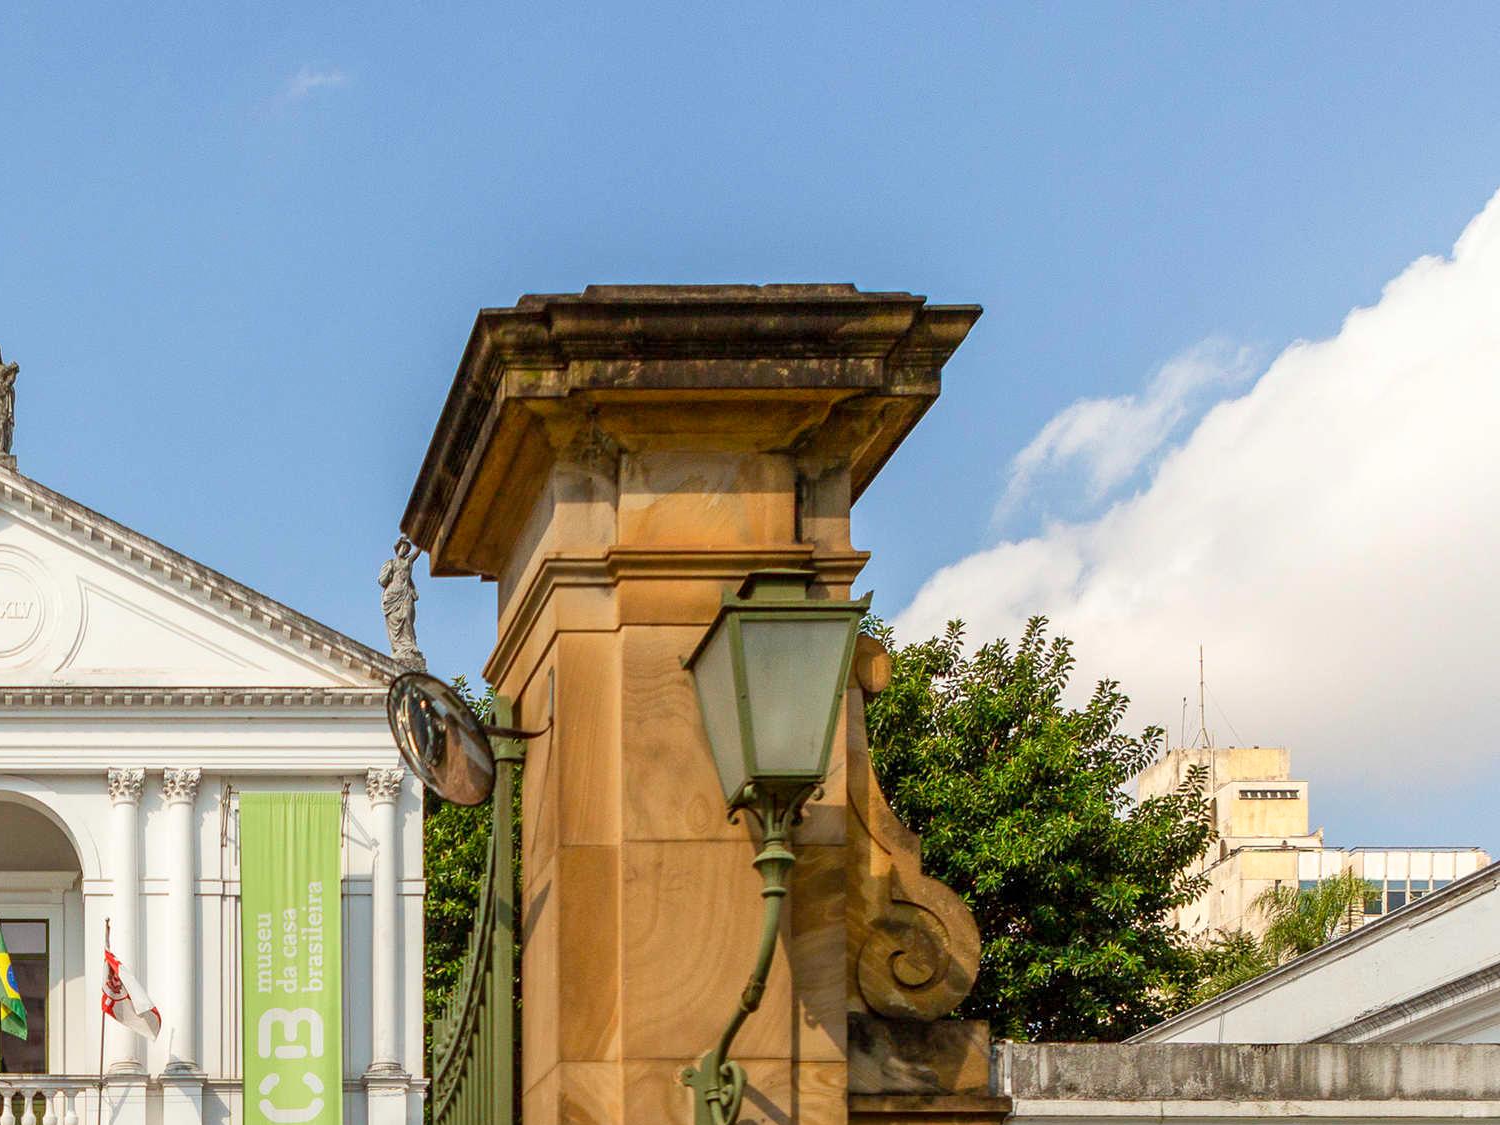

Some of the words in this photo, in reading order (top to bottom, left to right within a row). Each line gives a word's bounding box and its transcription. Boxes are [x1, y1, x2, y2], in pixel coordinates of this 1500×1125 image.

[257, 913, 272, 993] museu
[283, 907, 298, 957] casa
[302, 881, 323, 992] brasileira
[276, 966, 298, 993] da
